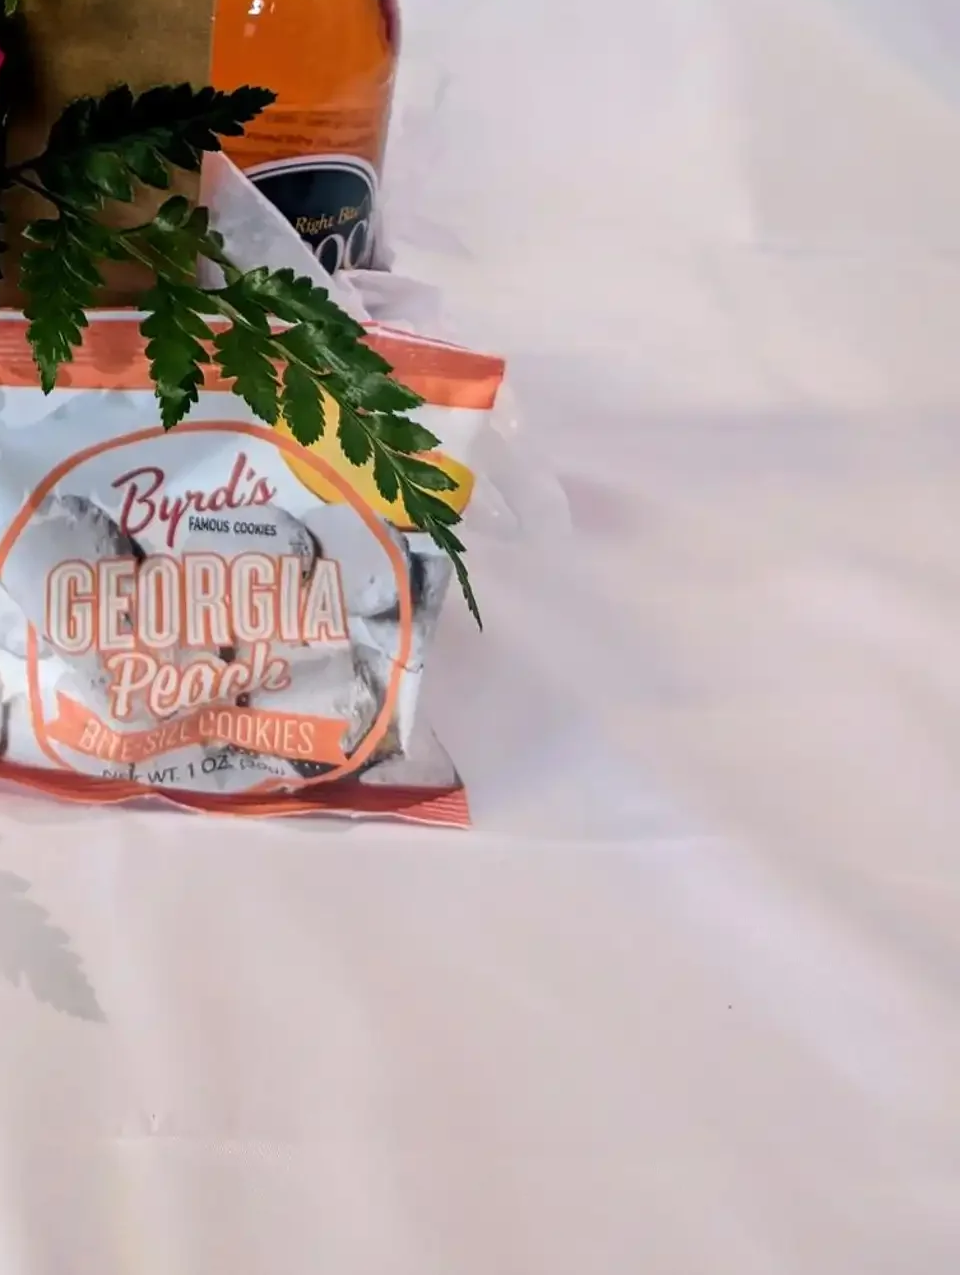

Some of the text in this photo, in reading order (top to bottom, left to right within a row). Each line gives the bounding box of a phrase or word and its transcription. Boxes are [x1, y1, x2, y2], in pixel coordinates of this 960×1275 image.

[295, 213, 335, 236] Right
[110, 451, 277, 548] Byrd's
[188, 515, 278, 536] FAMOUS COOKIES
[45, 551, 351, 654] GEORGIA
[105, 640, 292, 721] Peach
[198, 710, 316, 755] COOKIES
[147, 766, 181, 784] WT.
[187, 761, 195, 780] 1
